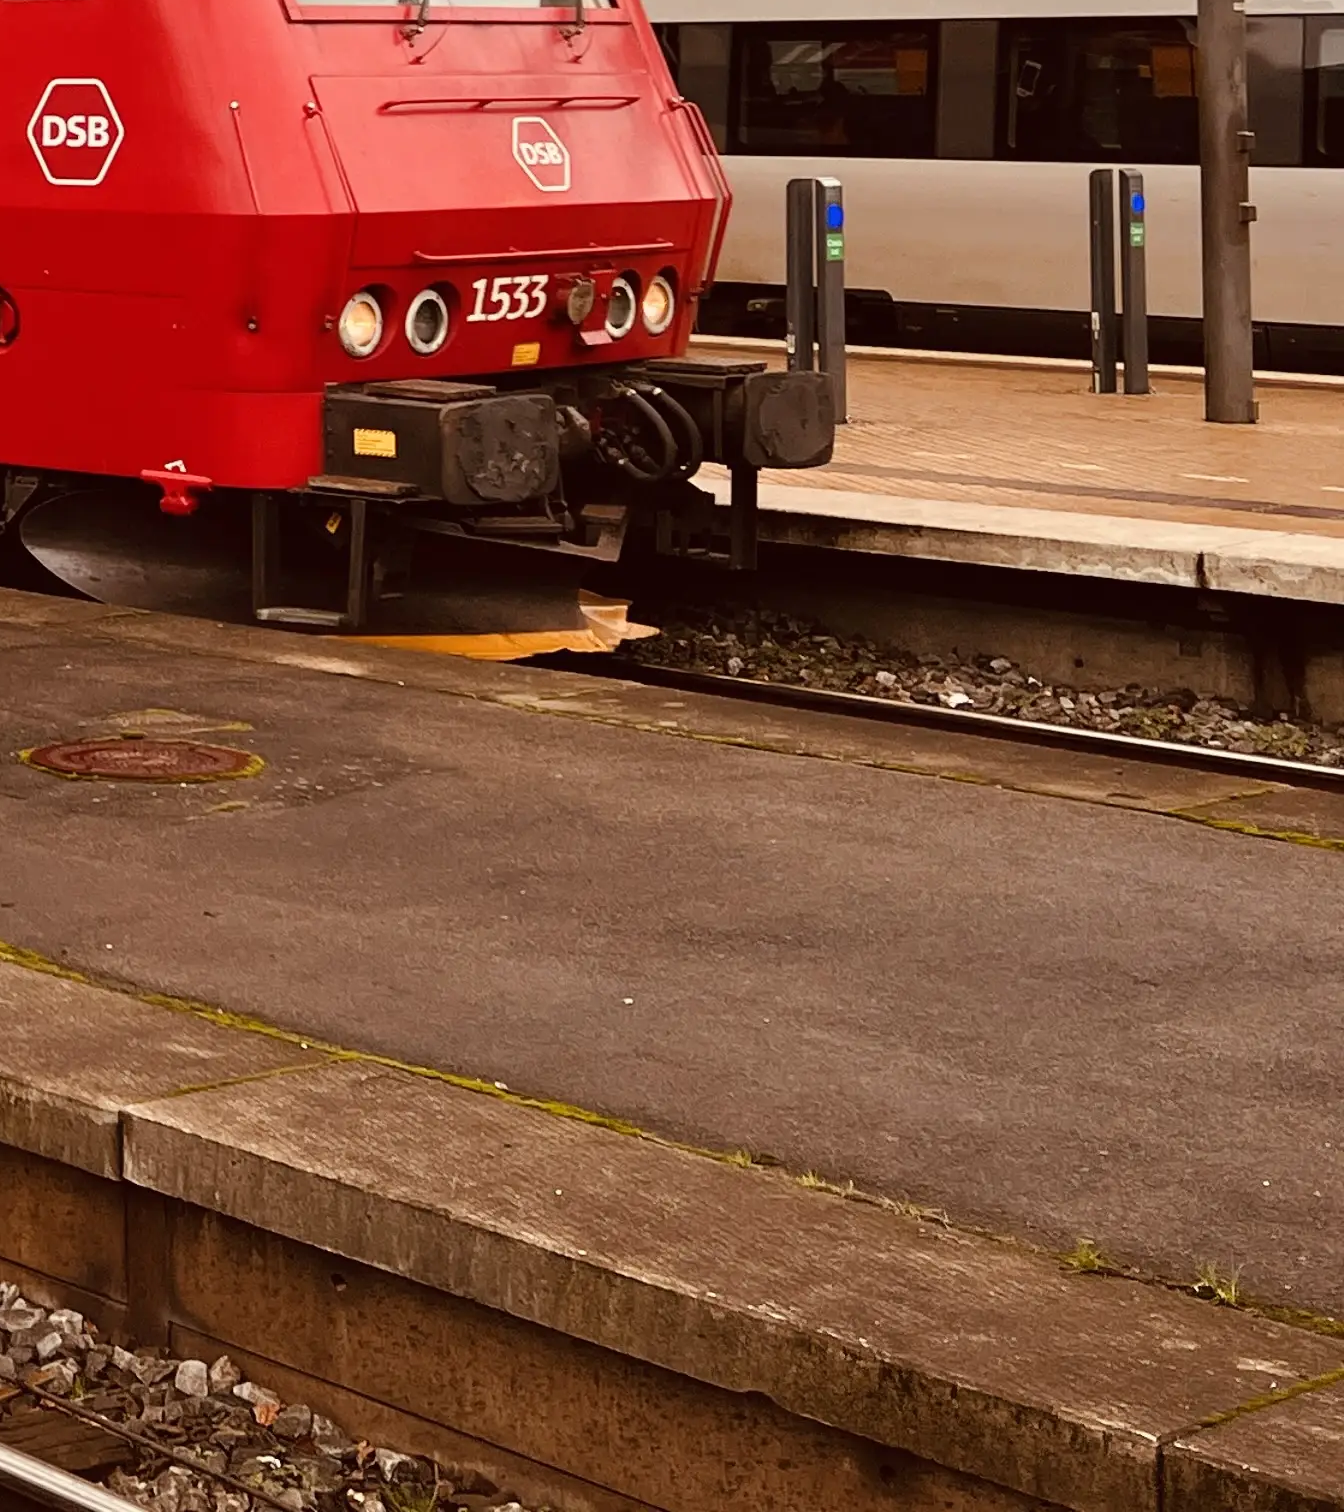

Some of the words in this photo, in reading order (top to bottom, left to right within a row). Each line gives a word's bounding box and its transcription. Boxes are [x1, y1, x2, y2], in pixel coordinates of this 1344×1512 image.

[42, 115, 109, 148] DSB
[519, 141, 563, 165] DSB
[466, 274, 549, 322] 1533
